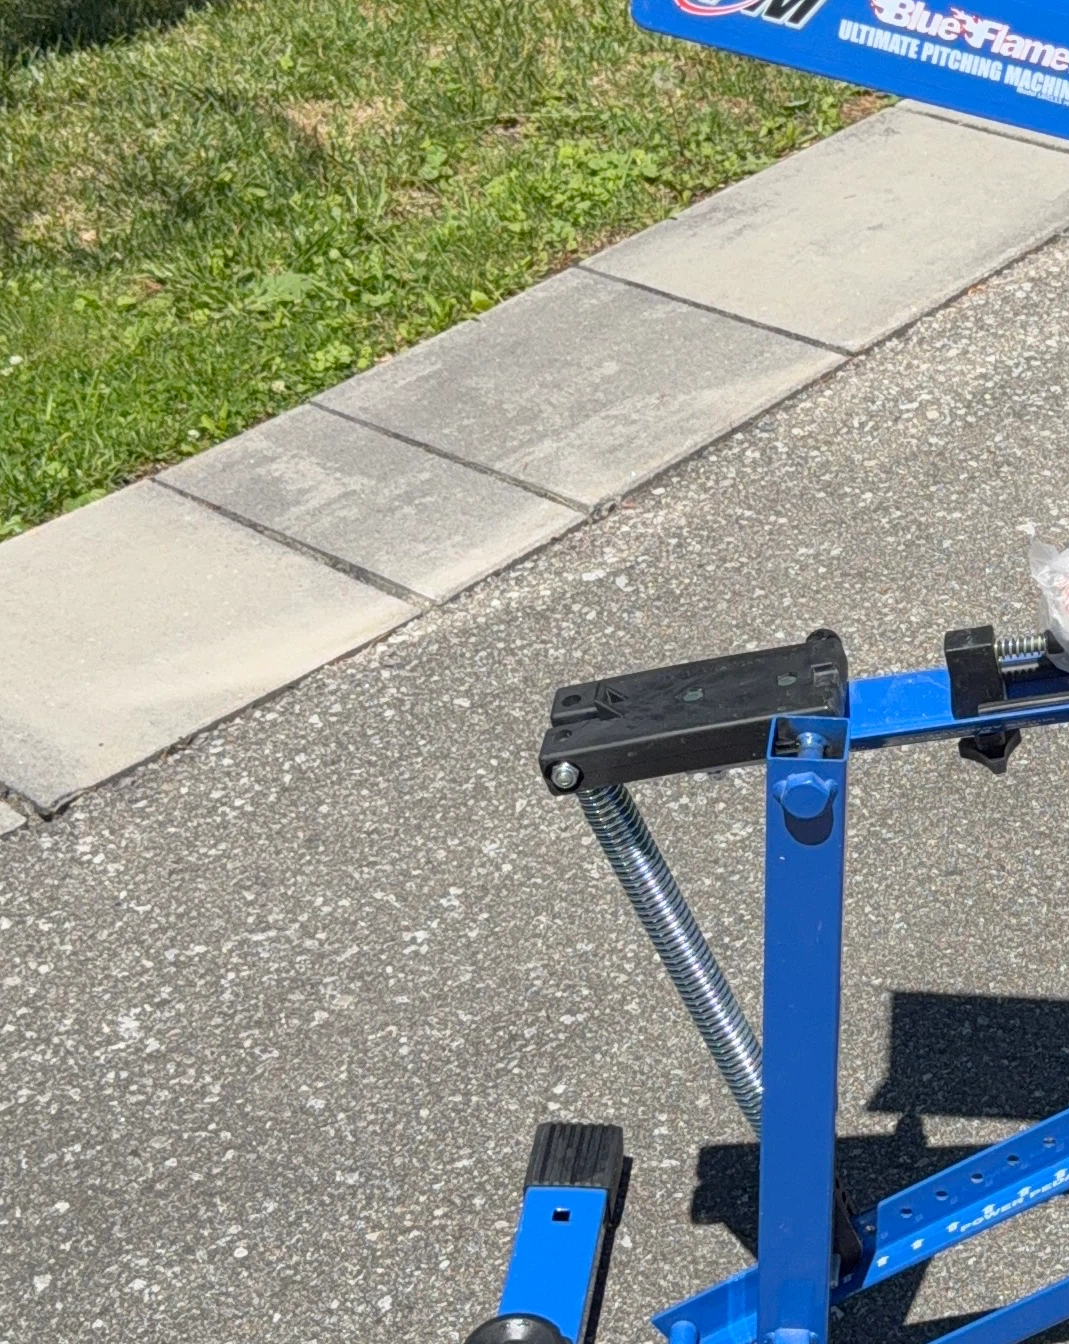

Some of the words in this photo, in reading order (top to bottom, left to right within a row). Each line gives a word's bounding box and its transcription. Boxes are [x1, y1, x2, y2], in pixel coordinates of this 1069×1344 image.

[838, 19, 920, 60] ULTIMATE
[920, 41, 1003, 82] PITCHING
[960, 1195, 1025, 1233] POWER
